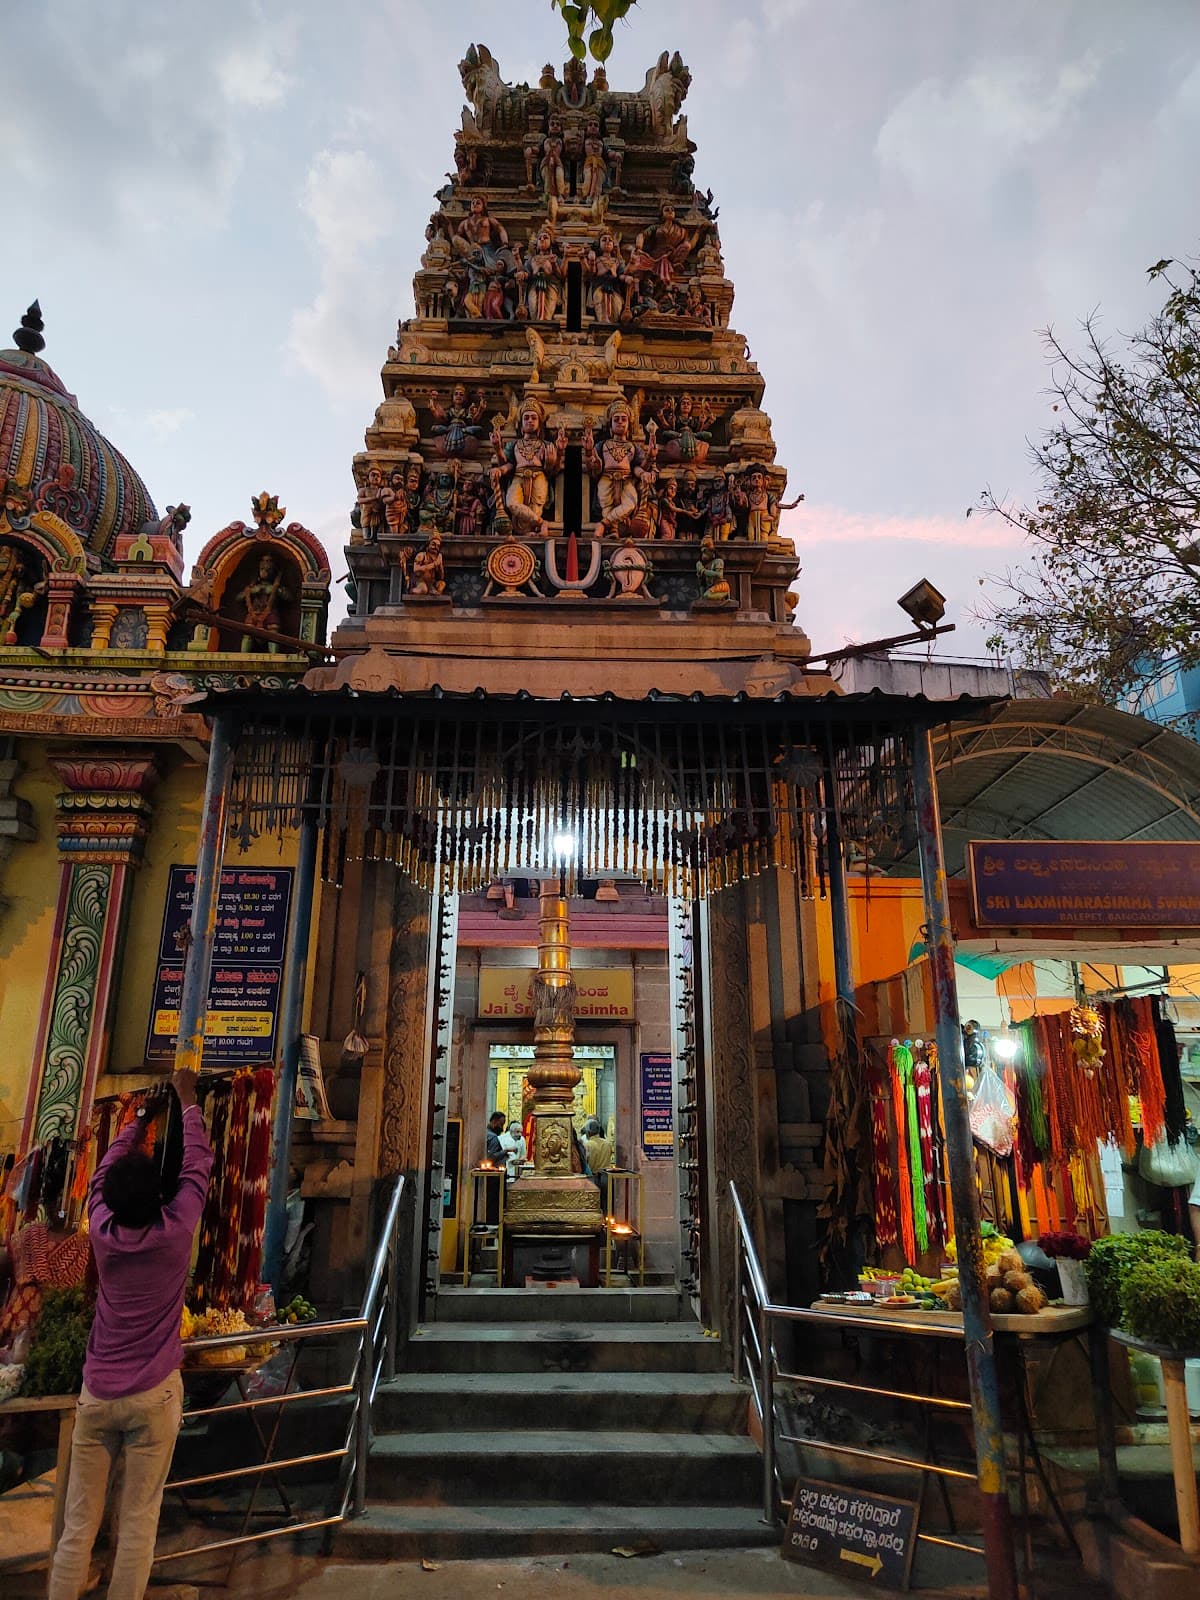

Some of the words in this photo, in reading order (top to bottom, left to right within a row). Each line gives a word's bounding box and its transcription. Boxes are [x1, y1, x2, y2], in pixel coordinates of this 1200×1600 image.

[986, 895, 1010, 909] SRI
[484, 1003, 508, 1015] Jai
[514, 1003, 535, 1015] Sr
[572, 1003, 629, 1015] asimha
[800, 1488, 819, 1509] ಇಲ್ಲಿ
[819, 1493, 849, 1516] ಚಪ್ಪಲಿ
[838, 1520, 864, 1541] ಚಪ್ಪಲಿ
